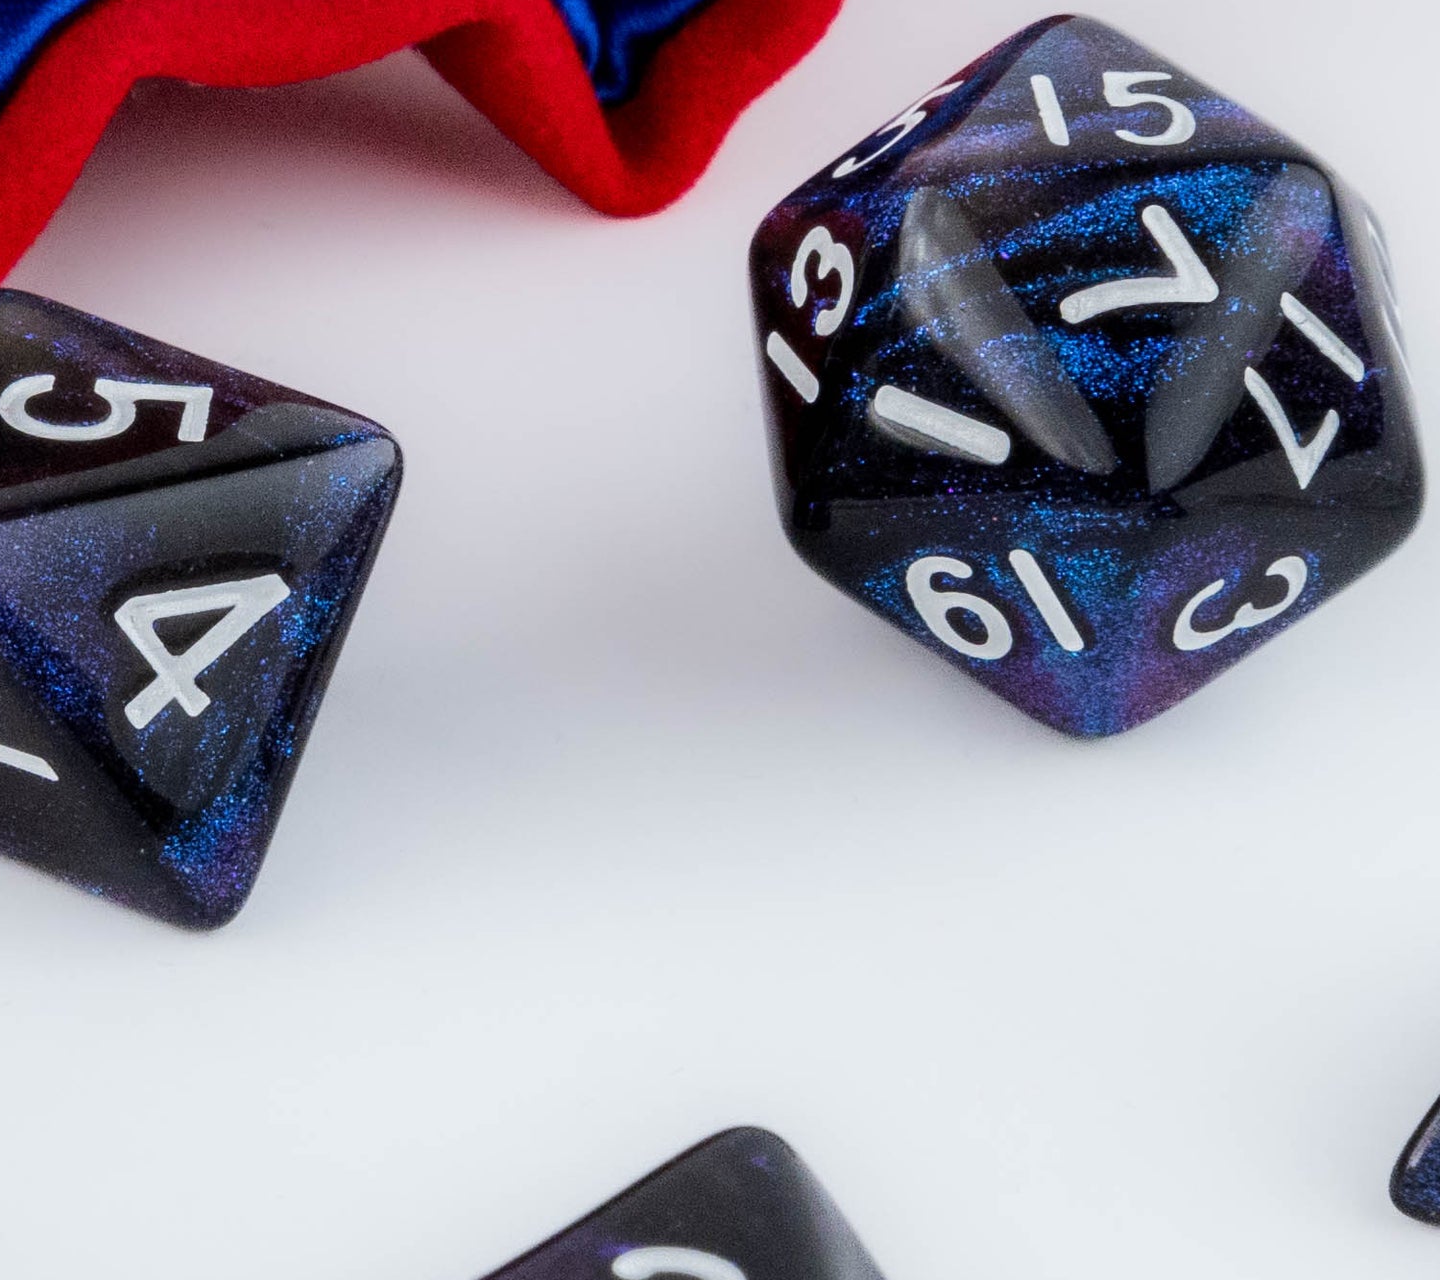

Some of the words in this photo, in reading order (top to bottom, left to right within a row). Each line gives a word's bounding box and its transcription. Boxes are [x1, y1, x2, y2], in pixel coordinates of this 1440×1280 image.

[1030, 70, 1197, 147] 15
[765, 224, 856, 405] 13
[1058, 203, 1220, 325] 7
[872, 384, 1011, 465] 1
[1242, 290, 1366, 491] 17
[113, 572, 292, 731] 4
[905, 548, 1084, 660] 19
[1172, 555, 1308, 651] 3
